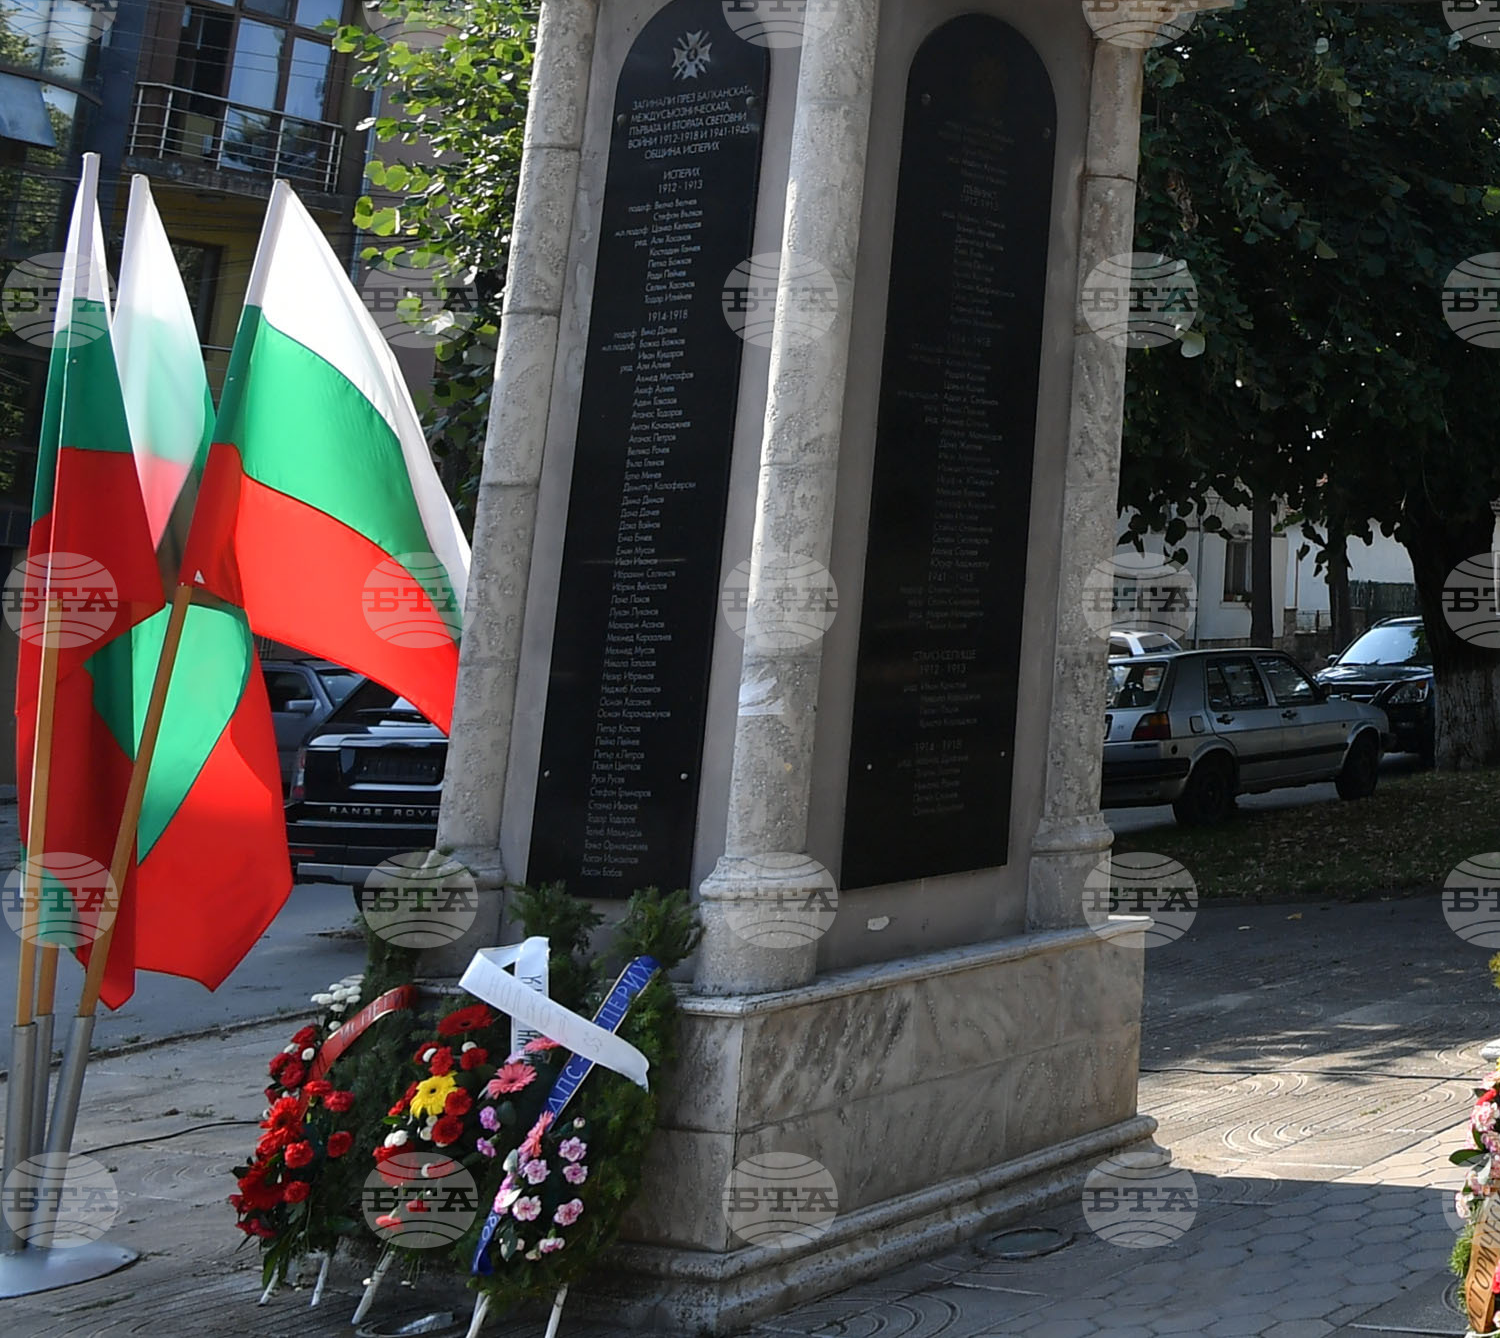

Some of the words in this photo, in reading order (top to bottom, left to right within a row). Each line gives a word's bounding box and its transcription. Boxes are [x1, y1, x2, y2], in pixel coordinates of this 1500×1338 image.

[329, 806, 383, 816] RANGE
[394, 809, 440, 818] ROVE
[598, 959, 656, 1033] СПЕРИХ
